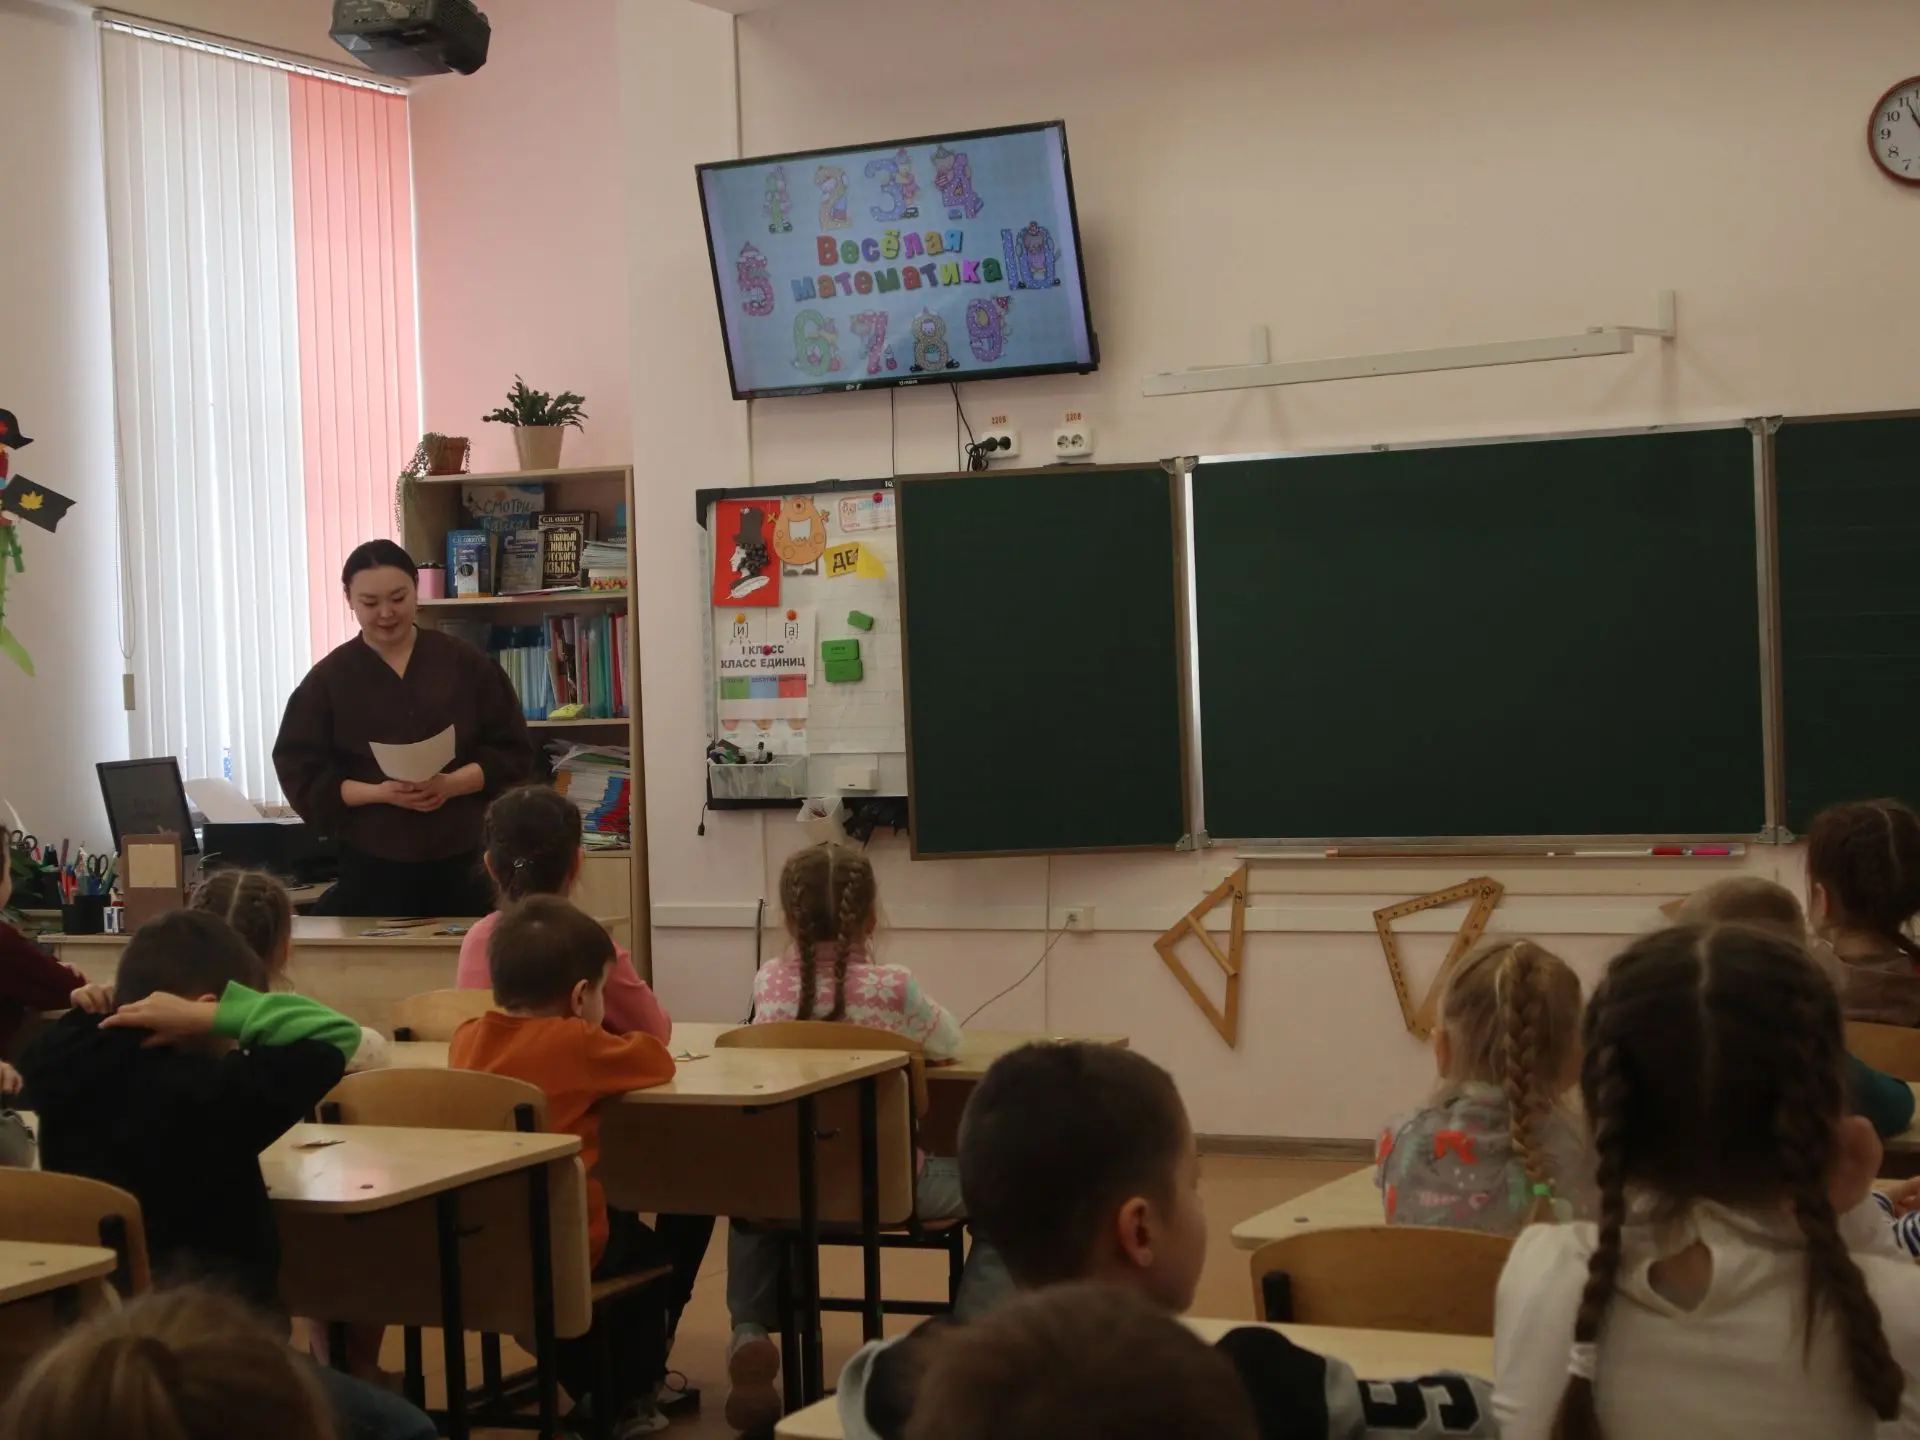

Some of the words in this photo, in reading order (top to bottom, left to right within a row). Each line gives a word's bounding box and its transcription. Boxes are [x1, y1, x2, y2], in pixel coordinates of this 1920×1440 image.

[1899, 97, 1910, 107] 11
[1886, 111, 1901, 121] 10
[1880, 128, 1892, 140] 9
[1887, 146, 1900, 158] 8
[1902, 159, 1912, 171] 7
[814, 165, 852, 231] 2
[864, 157, 907, 222] 3
[937, 150, 984, 220] 4
[816, 228, 964, 266] Весёлая
[1000, 224, 1057, 291] 10
[736, 253, 775, 316] 5
[790, 257, 1004, 301] математика
[792, 309, 834, 376] 6
[855, 311, 890, 374] 7
[912, 313, 947, 372] 8
[965, 298, 1004, 362] 9
[832, 548, 860, 574] ДЕ
[748, 645, 785, 655] КЛСС
[720, 659, 757, 669] КЛАСС
[760, 658, 806, 669] ЕДИНИЦ
